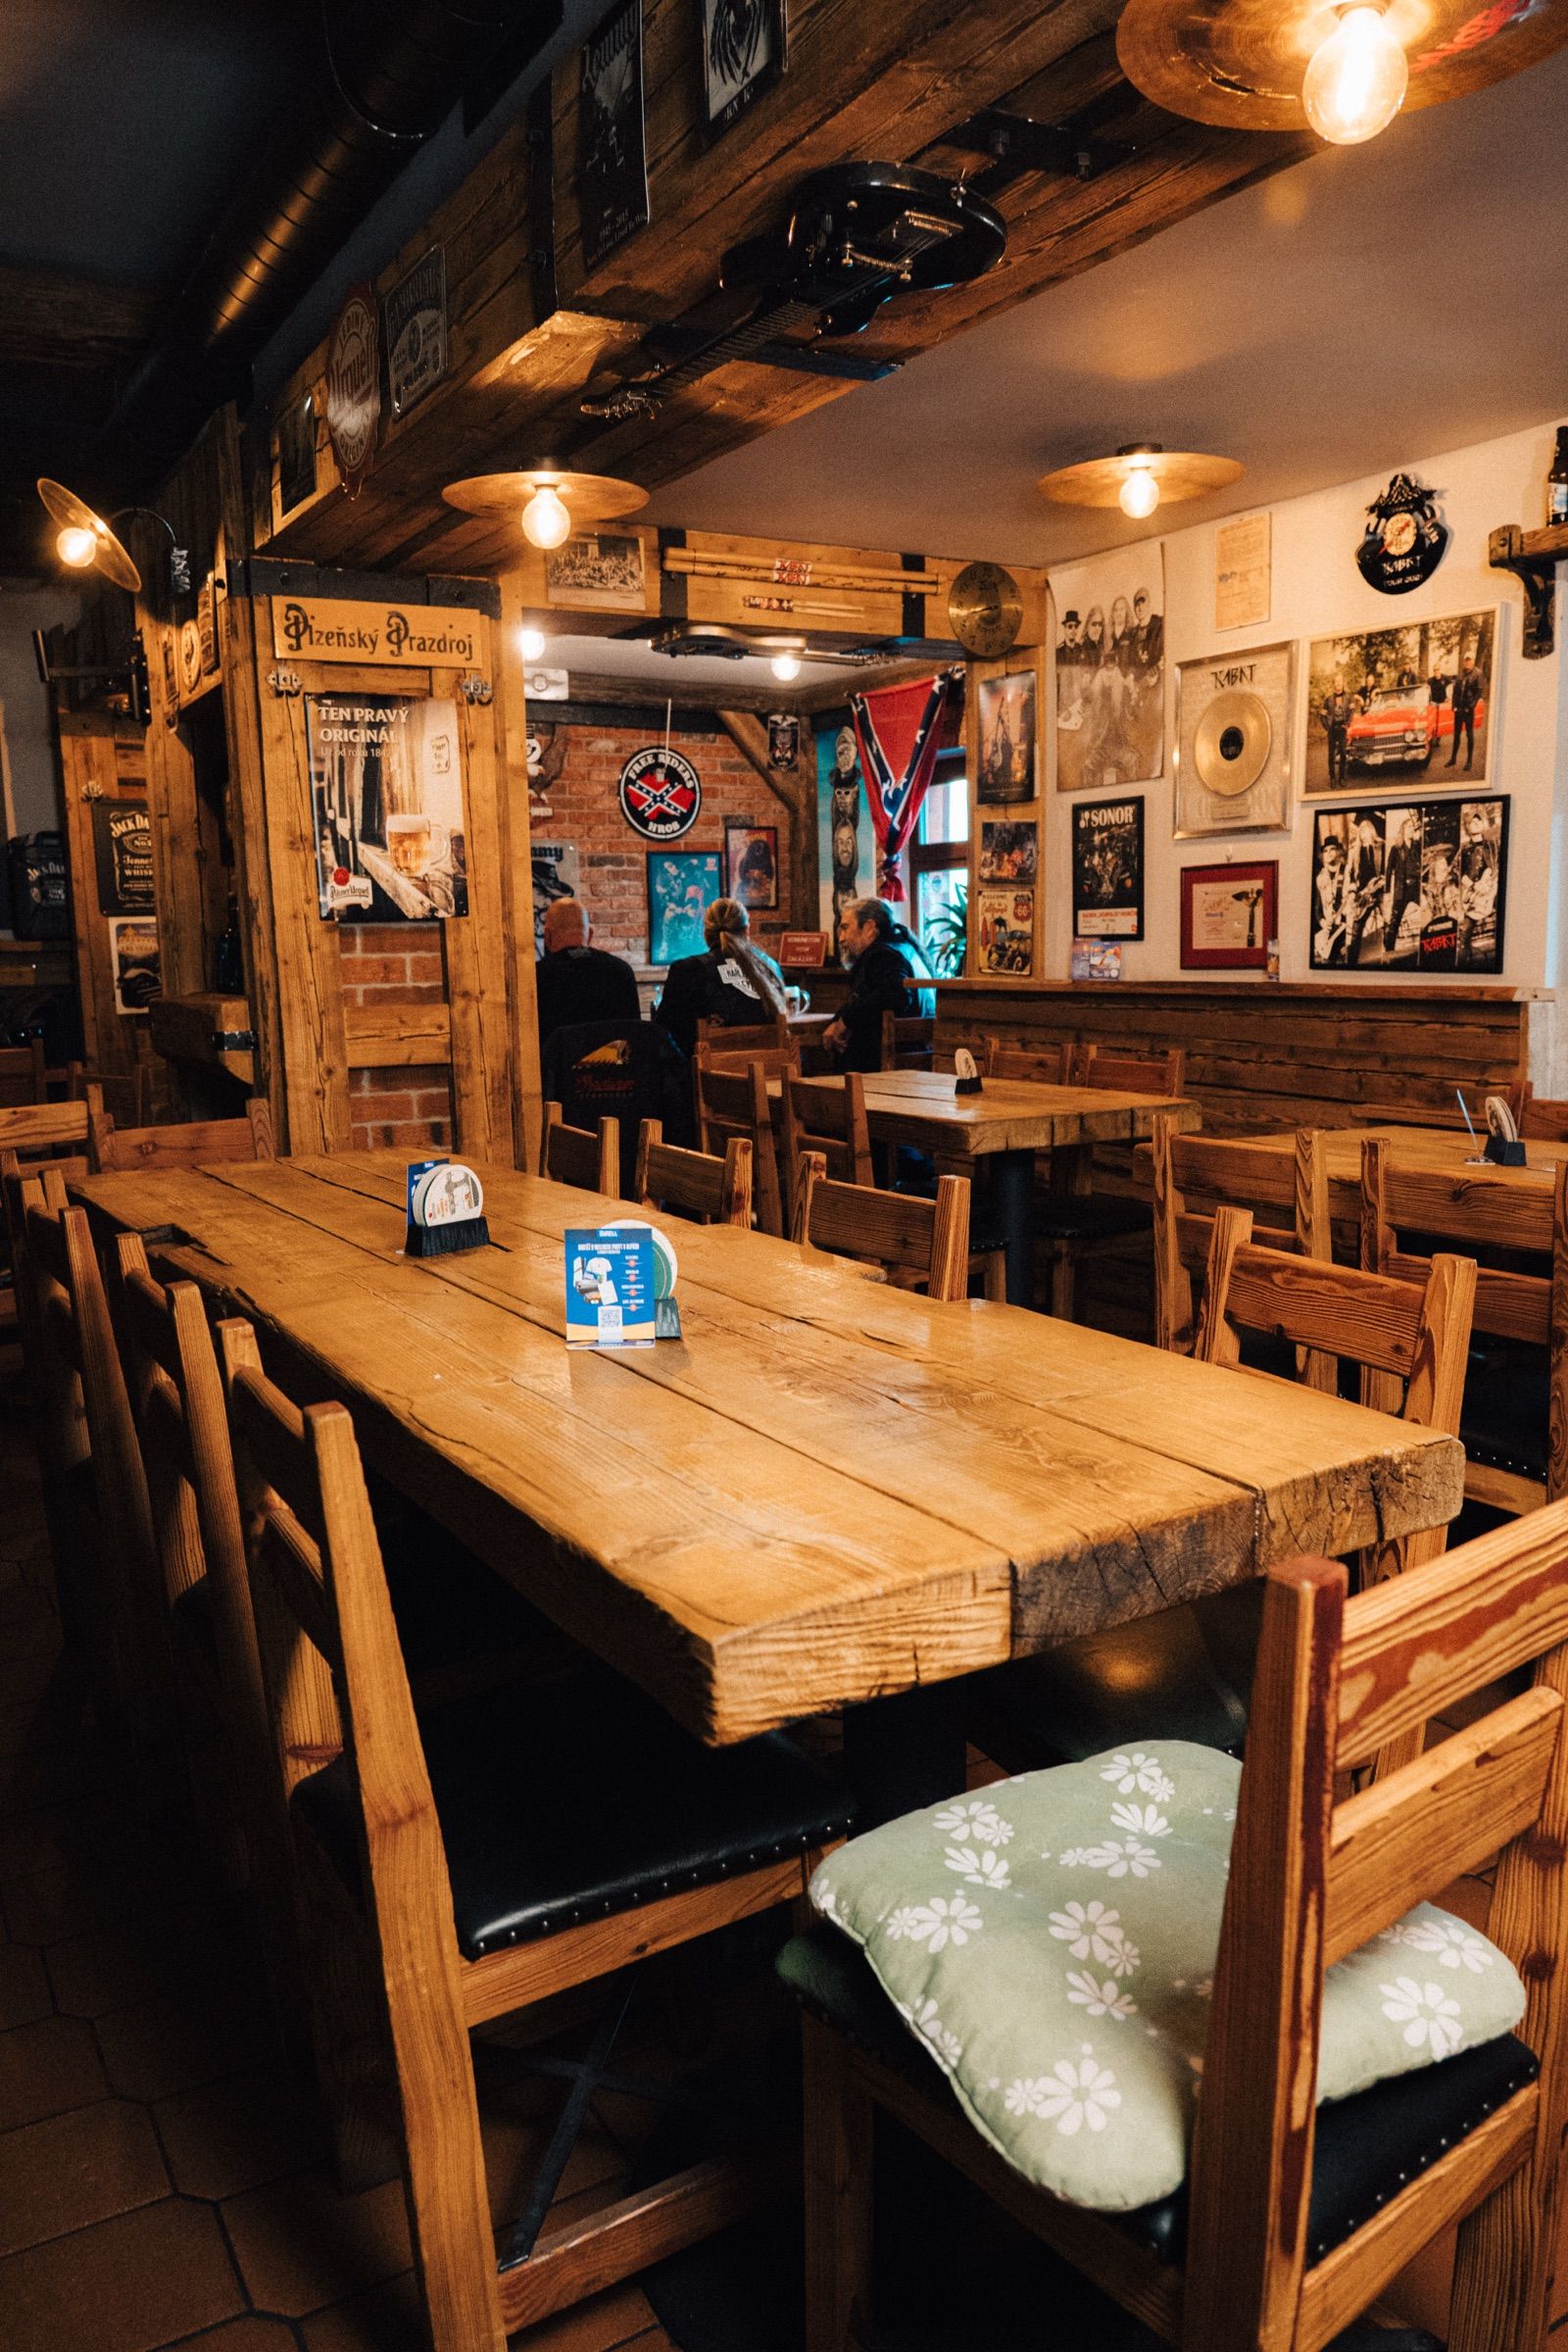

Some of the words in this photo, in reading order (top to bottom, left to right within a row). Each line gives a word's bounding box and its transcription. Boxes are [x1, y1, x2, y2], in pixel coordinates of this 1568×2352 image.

[386, 611, 473, 662] Prazdroj
[318, 707, 353, 721] TEN
[354, 707, 409, 723] PRAVÝ
[319, 726, 399, 744] ORIGINÁL
[628, 754, 656, 780] FREE
[658, 754, 695, 789] RIDERS
[110, 816, 136, 838] JACK
[1091, 807, 1134, 828] SONOR
[647, 821, 681, 834] HROB
[1017, 905, 1028, 918] 66
